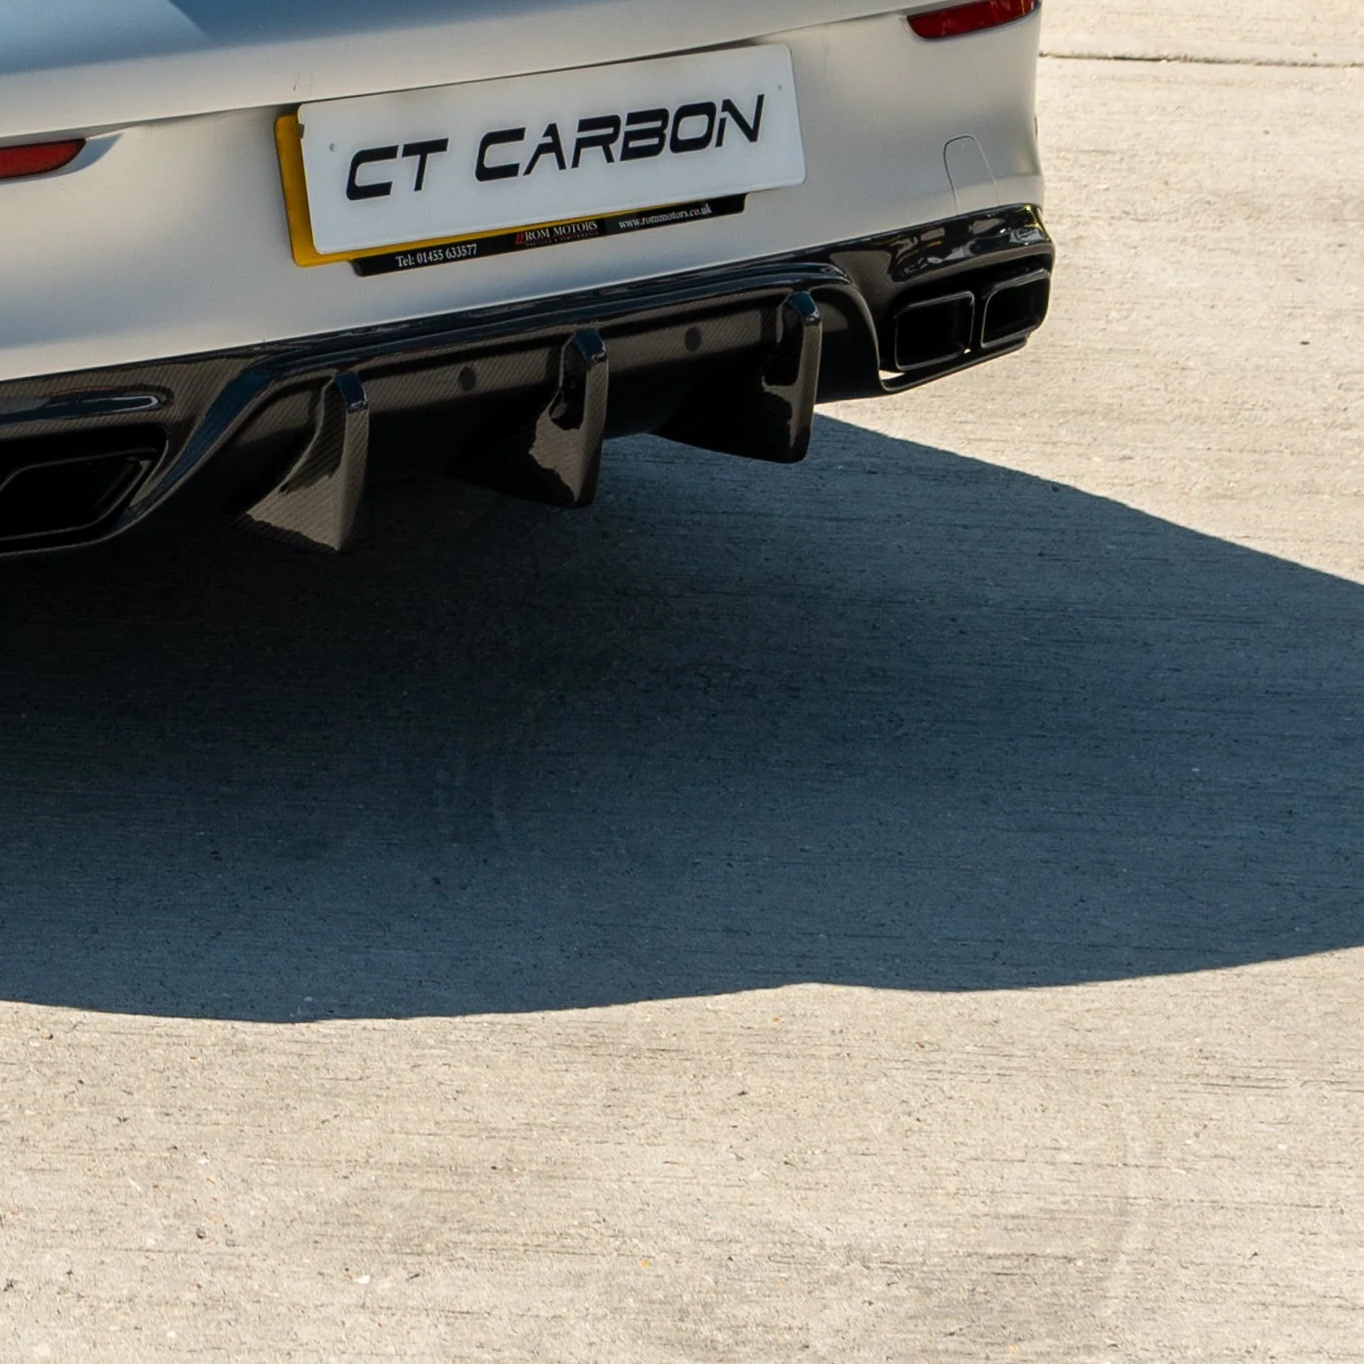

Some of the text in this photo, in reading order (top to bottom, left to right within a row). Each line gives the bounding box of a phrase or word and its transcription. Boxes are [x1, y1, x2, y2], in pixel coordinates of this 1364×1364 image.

[345, 93, 765, 201] CT CARBON
[553, 221, 598, 237] MOTORS
[618, 202, 713, 230] www.rommotors.co.uk
[395, 243, 478, 268] Tel: 01455 633577
